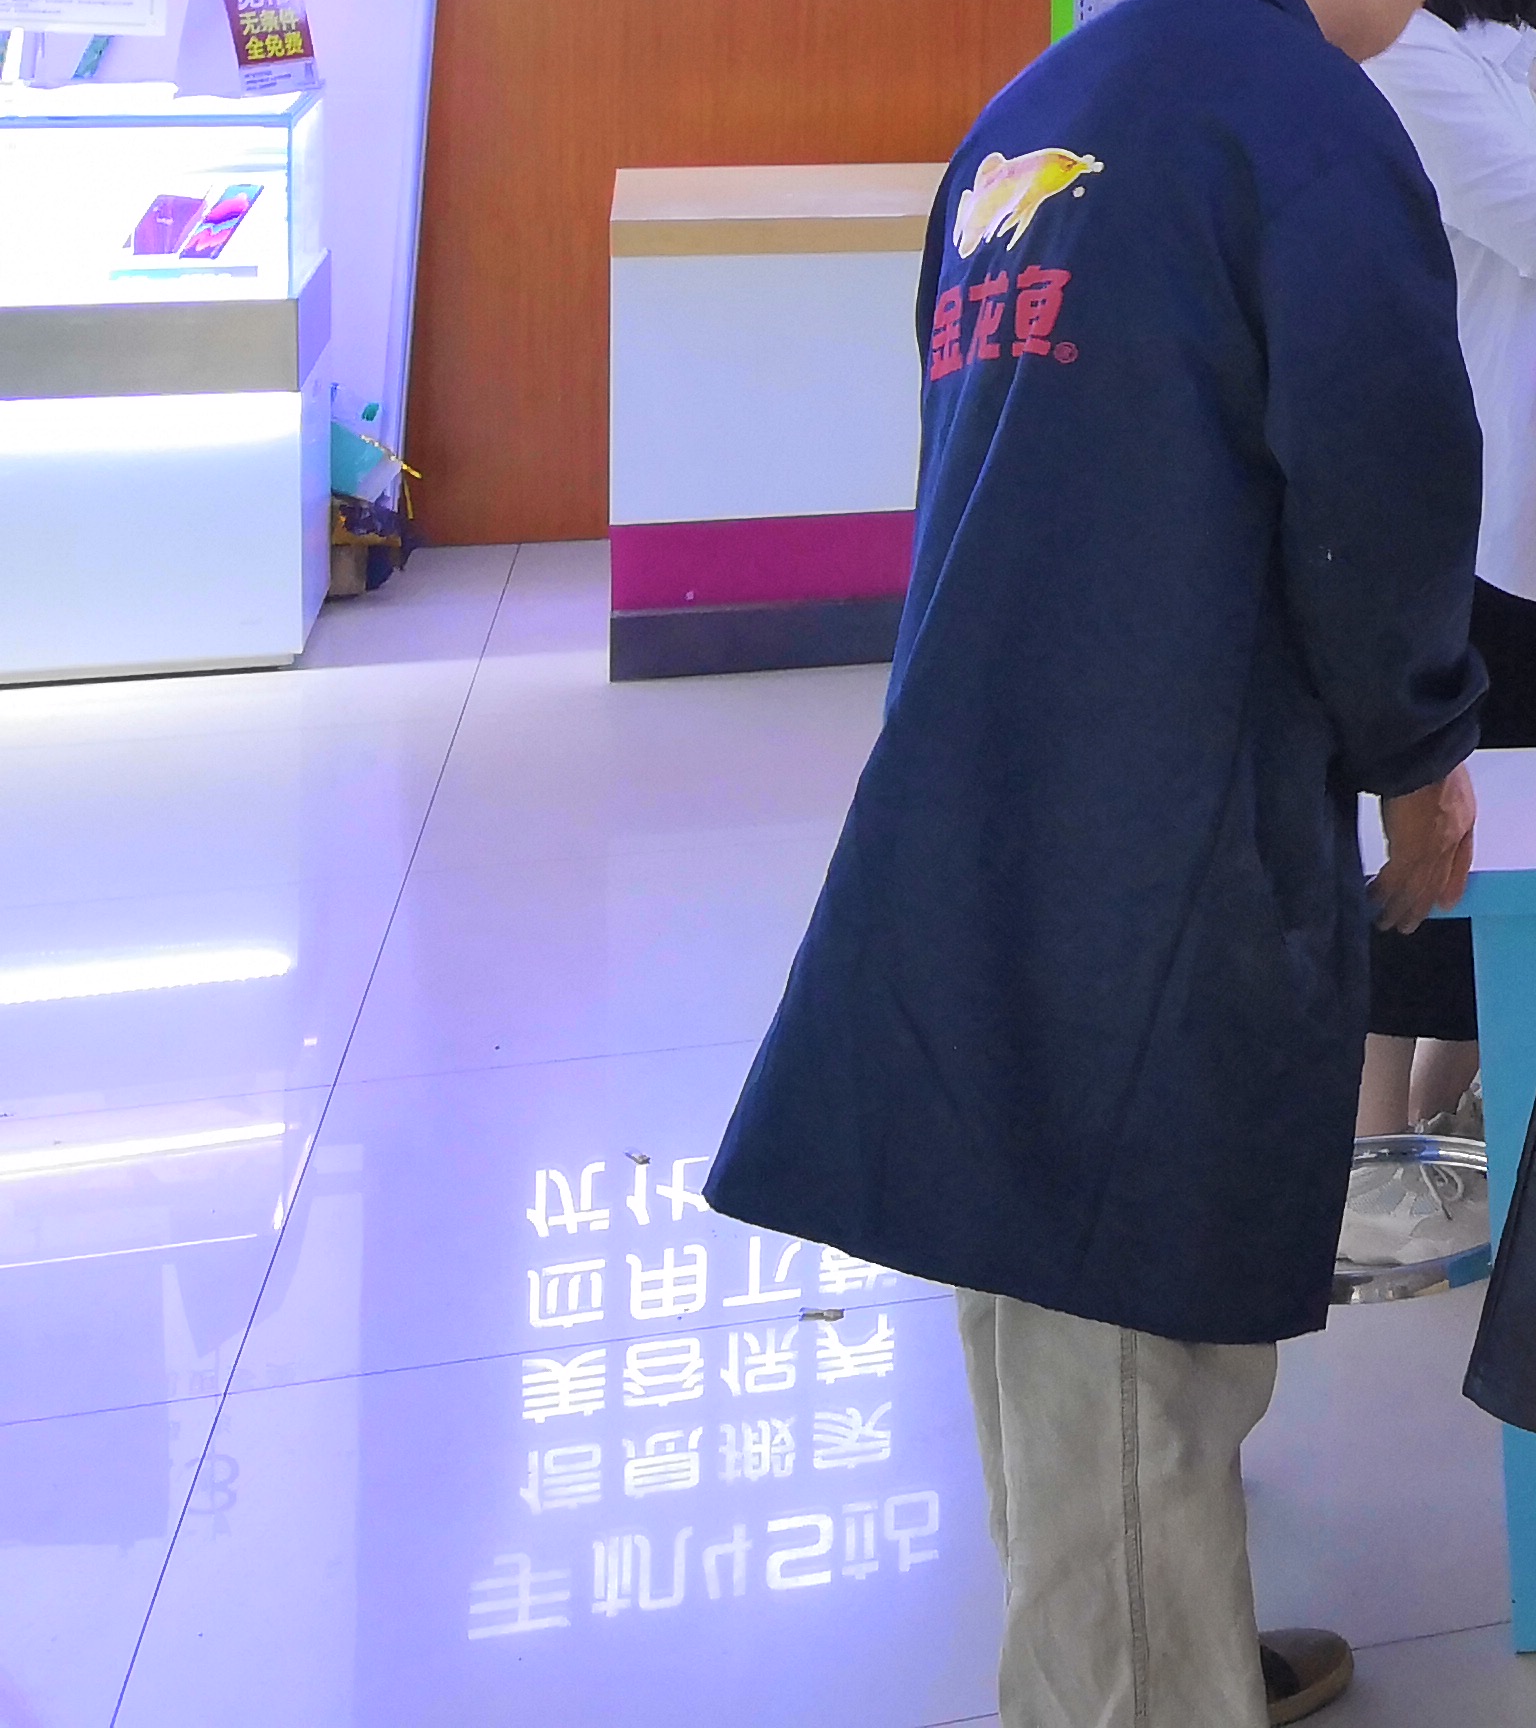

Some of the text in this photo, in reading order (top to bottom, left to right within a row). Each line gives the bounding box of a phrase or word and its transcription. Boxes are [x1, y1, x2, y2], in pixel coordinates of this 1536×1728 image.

[239, 11, 300, 36] 无条件
[244, 35, 305, 61] 全免费
